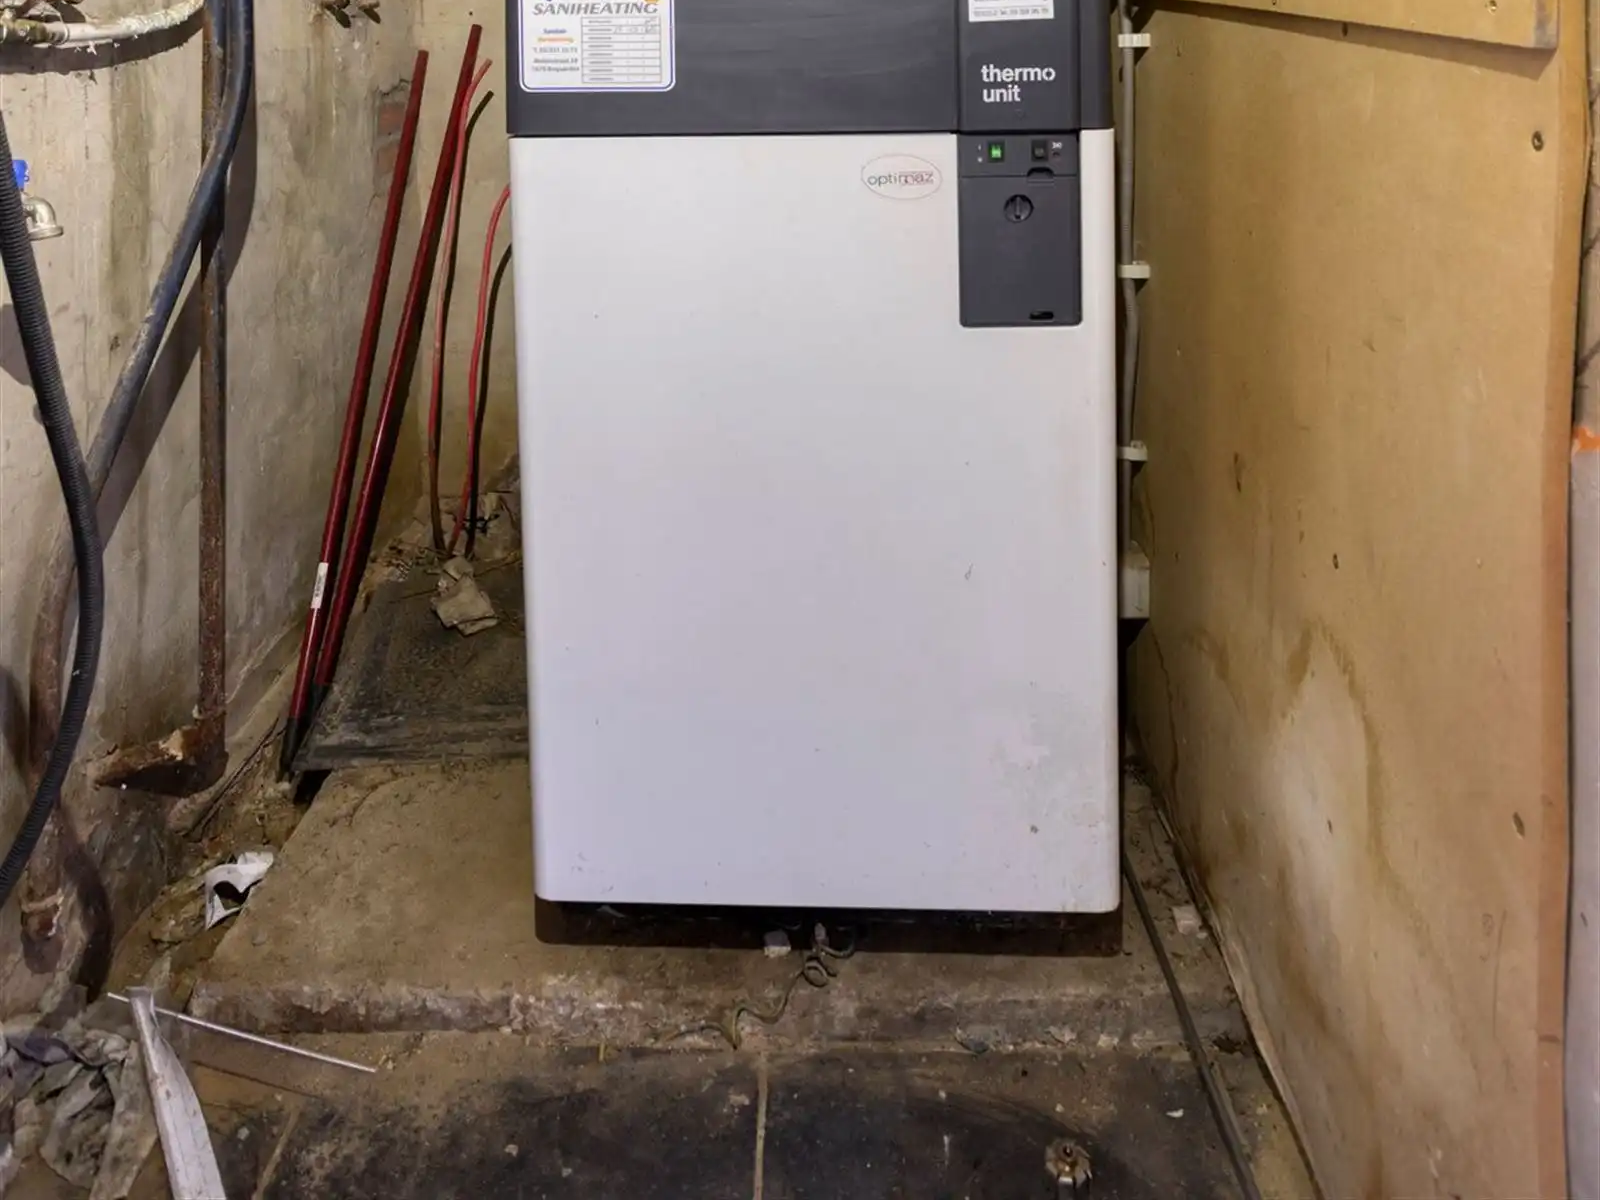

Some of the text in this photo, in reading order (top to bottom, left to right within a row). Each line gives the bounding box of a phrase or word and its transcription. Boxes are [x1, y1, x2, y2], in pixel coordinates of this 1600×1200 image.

[532, 2, 659, 16] SANIHEATING
[981, 63, 1056, 82] thermo
[982, 84, 1021, 103] unit
[867, 171, 934, 187] optimaz
